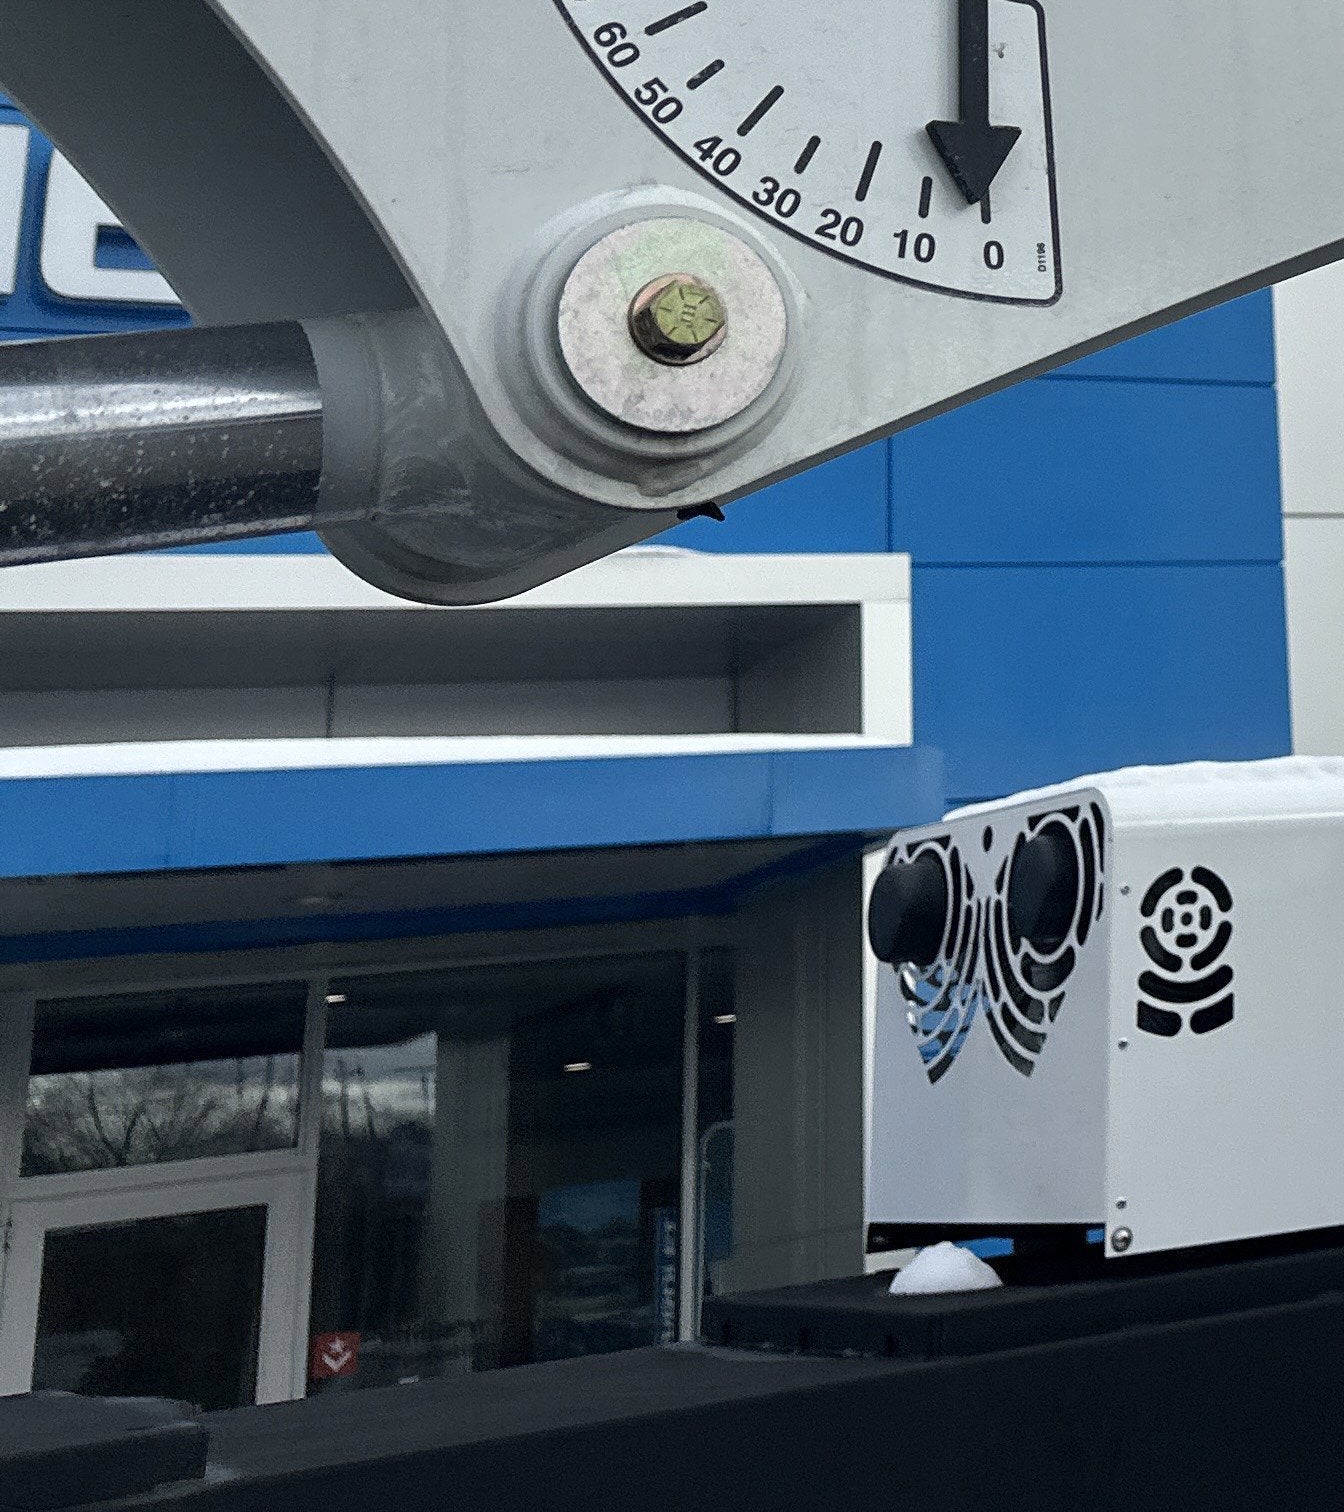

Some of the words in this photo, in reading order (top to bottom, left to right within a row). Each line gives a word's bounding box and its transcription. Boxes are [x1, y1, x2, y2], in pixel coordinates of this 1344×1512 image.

[593, 21, 641, 68] 60
[634, 77, 683, 126] 50
[692, 136, 742, 178] 40
[751, 176, 801, 219] 30
[814, 209, 864, 247] 20
[893, 229, 936, 264] 10
[984, 241, 1004, 270] 0
